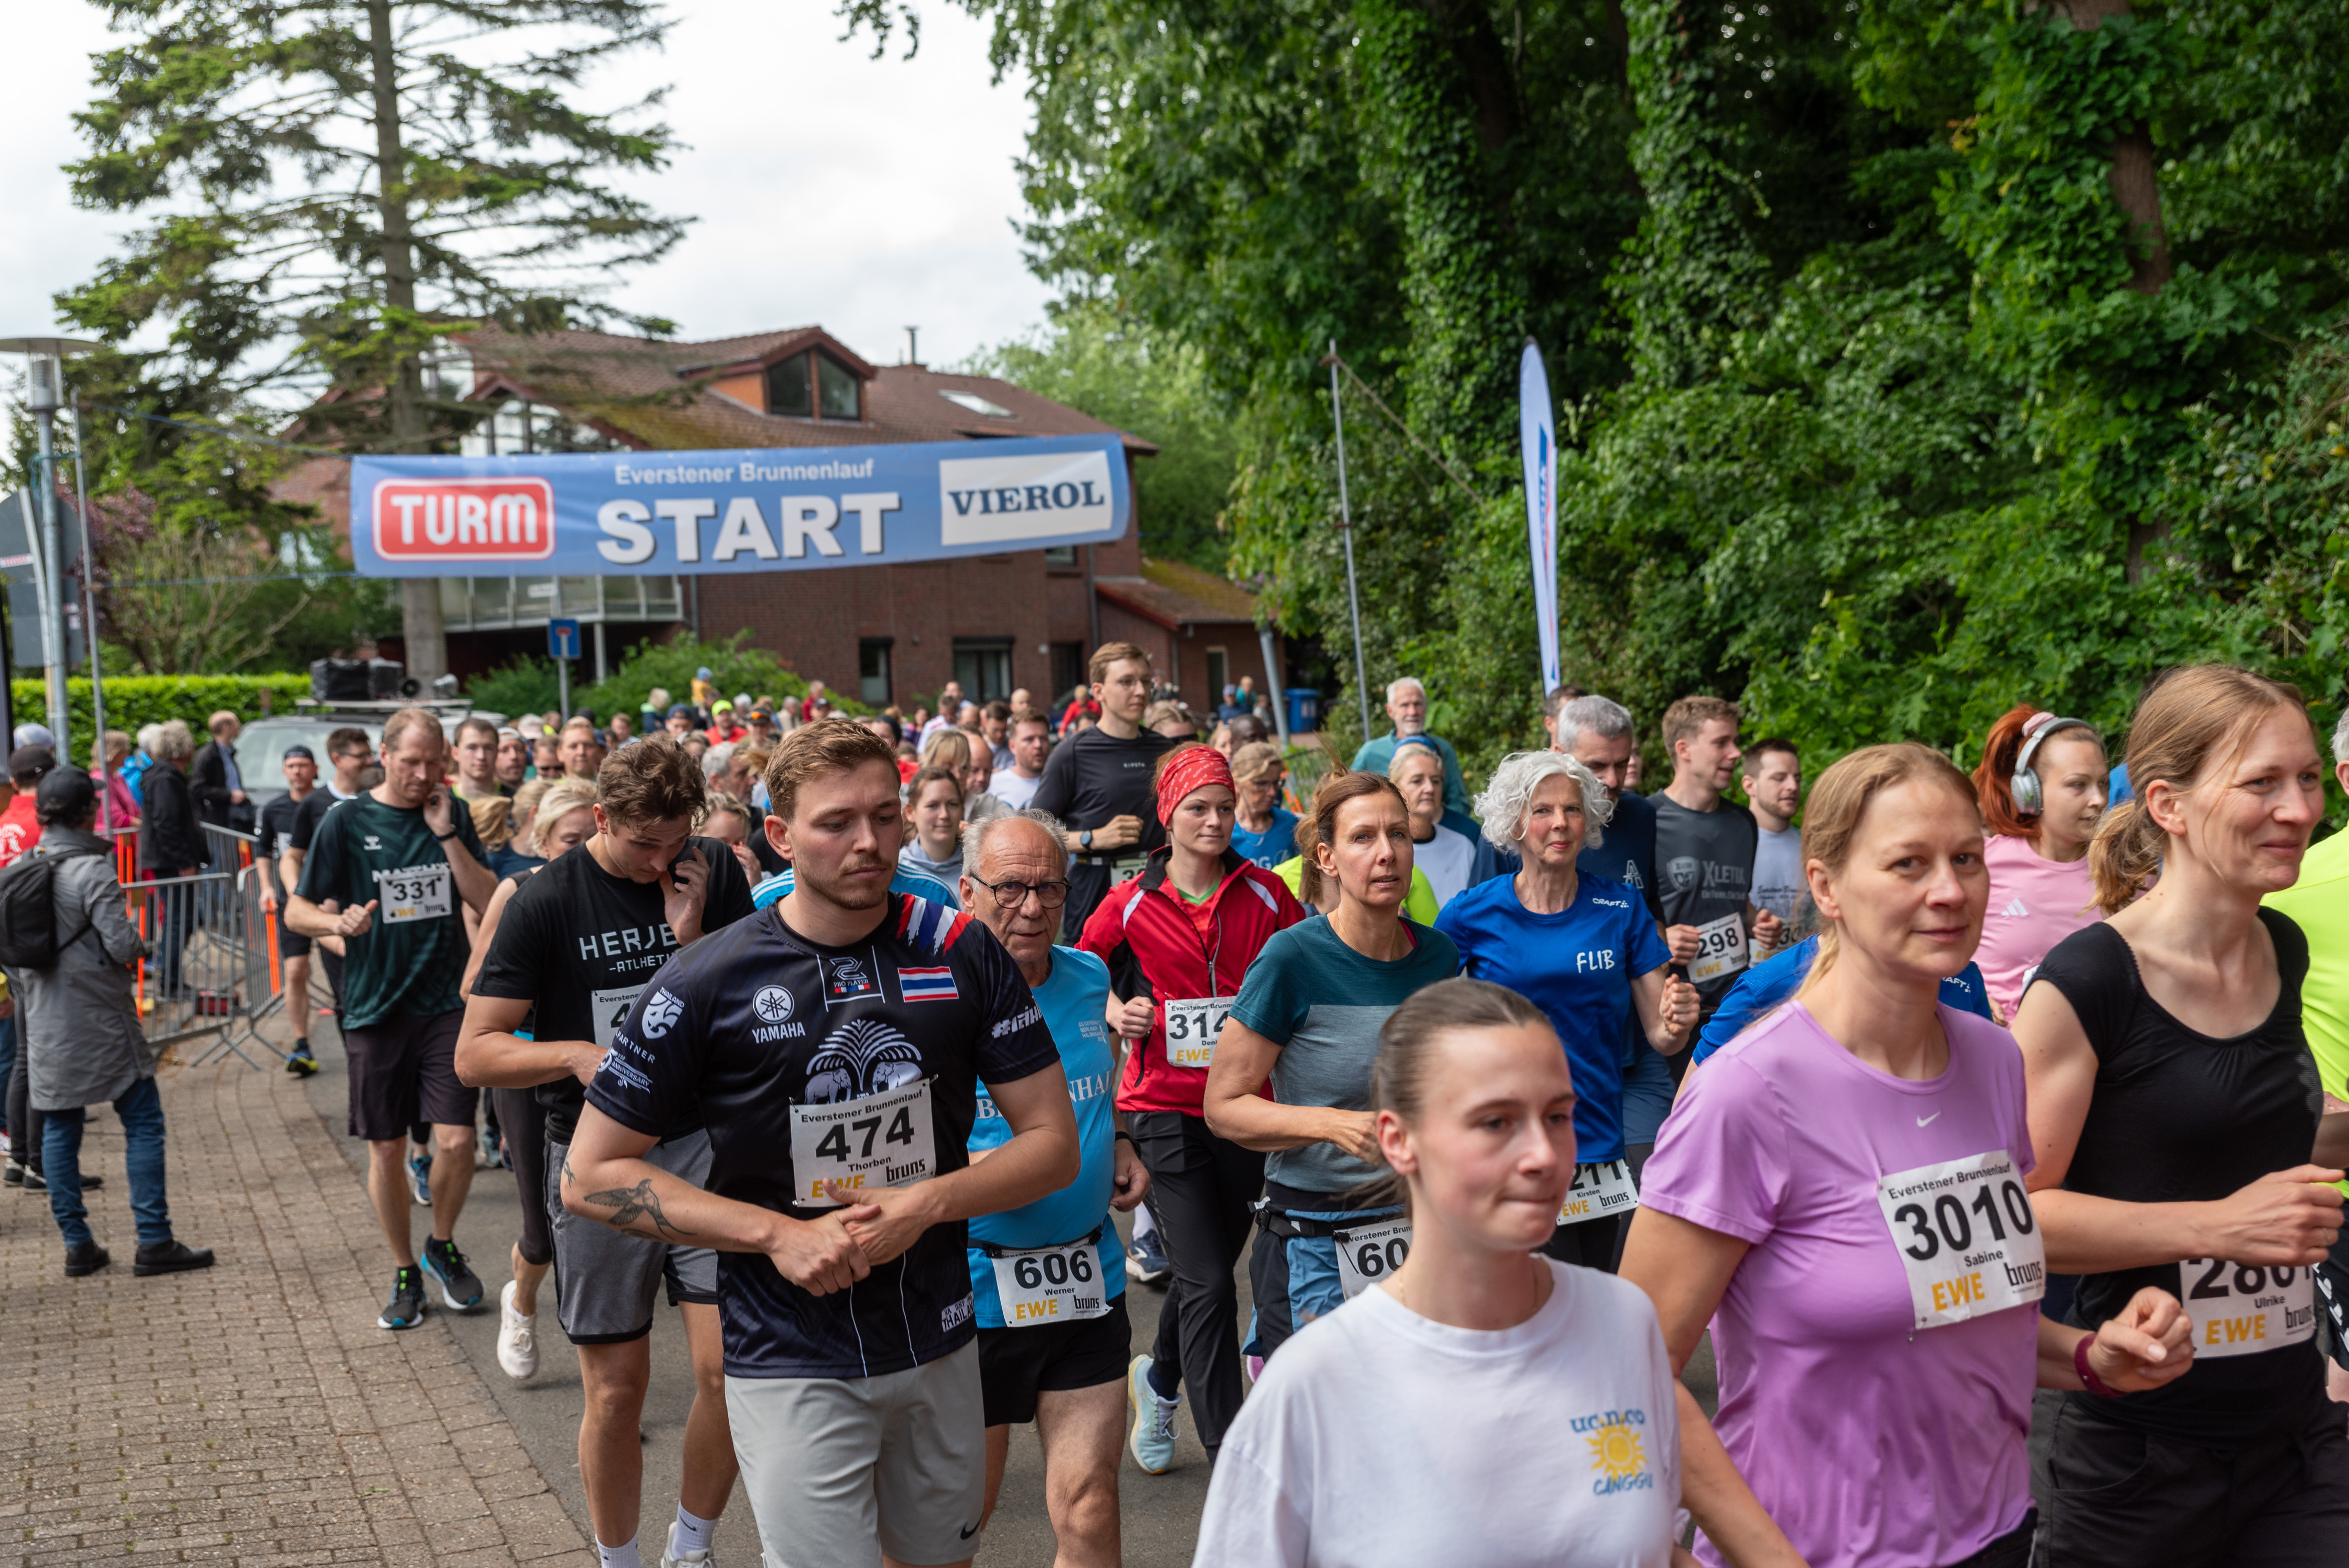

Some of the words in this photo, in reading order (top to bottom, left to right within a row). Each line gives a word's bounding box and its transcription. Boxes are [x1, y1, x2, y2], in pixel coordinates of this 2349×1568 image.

[615, 464, 734, 485] Everstener
[740, 458, 874, 481] Brunnenlauf
[948, 481, 1104, 516] VIEROL
[391, 493, 538, 545] TURM
[597, 492, 901, 564] START
[393, 879, 436, 901] 331
[1592, 898, 1621, 906] CRAFT
[579, 923, 679, 960] HERJE
[1698, 927, 1738, 959] 298
[609, 953, 674, 972] -ATLHETI
[1576, 949, 1615, 973] FLIB
[1697, 961, 1722, 977] EWE
[1942, 977, 1966, 988] AFT
[600, 993, 640, 1003] Everstene
[611, 1003, 631, 1028] 4
[1169, 1011, 1229, 1039] 314
[752, 1021, 806, 1044] YAMAHA
[1177, 1048, 1210, 1062] EWE
[611, 1061, 650, 1087] ANNIVERSARY
[801, 1108, 862, 1123] Everstener
[865, 1089, 923, 1114] Brunnenlauf
[815, 1105, 915, 1163] 474
[848, 1156, 892, 1172] Thorben
[886, 1158, 926, 1183] bruns
[1889, 1177, 1954, 1200] Everstener
[1956, 1160, 2012, 1184] Brunnenlauf
[1576, 1189, 1600, 1198] Kirsten
[1599, 1192, 1630, 1207] bruns
[1562, 1199, 1590, 1217] EWE
[1894, 1180, 2033, 1261] 3010
[1349, 1230, 1391, 1242] verstener
[1014, 1250, 1093, 1289] 606
[1357, 1238, 1409, 1277] 60
[1964, 1250, 2003, 1267] Sabine
[2003, 1261, 2042, 1286] bruns
[1045, 1287, 1075, 1296] Werner
[1073, 1294, 1099, 1309] bruns
[1931, 1272, 1986, 1312] EWE
[2255, 1295, 2285, 1309] Ulrike
[942, 1298, 974, 1331] THAILAN
[1016, 1298, 1058, 1320] EWE
[2205, 1314, 2266, 1345] EWE
